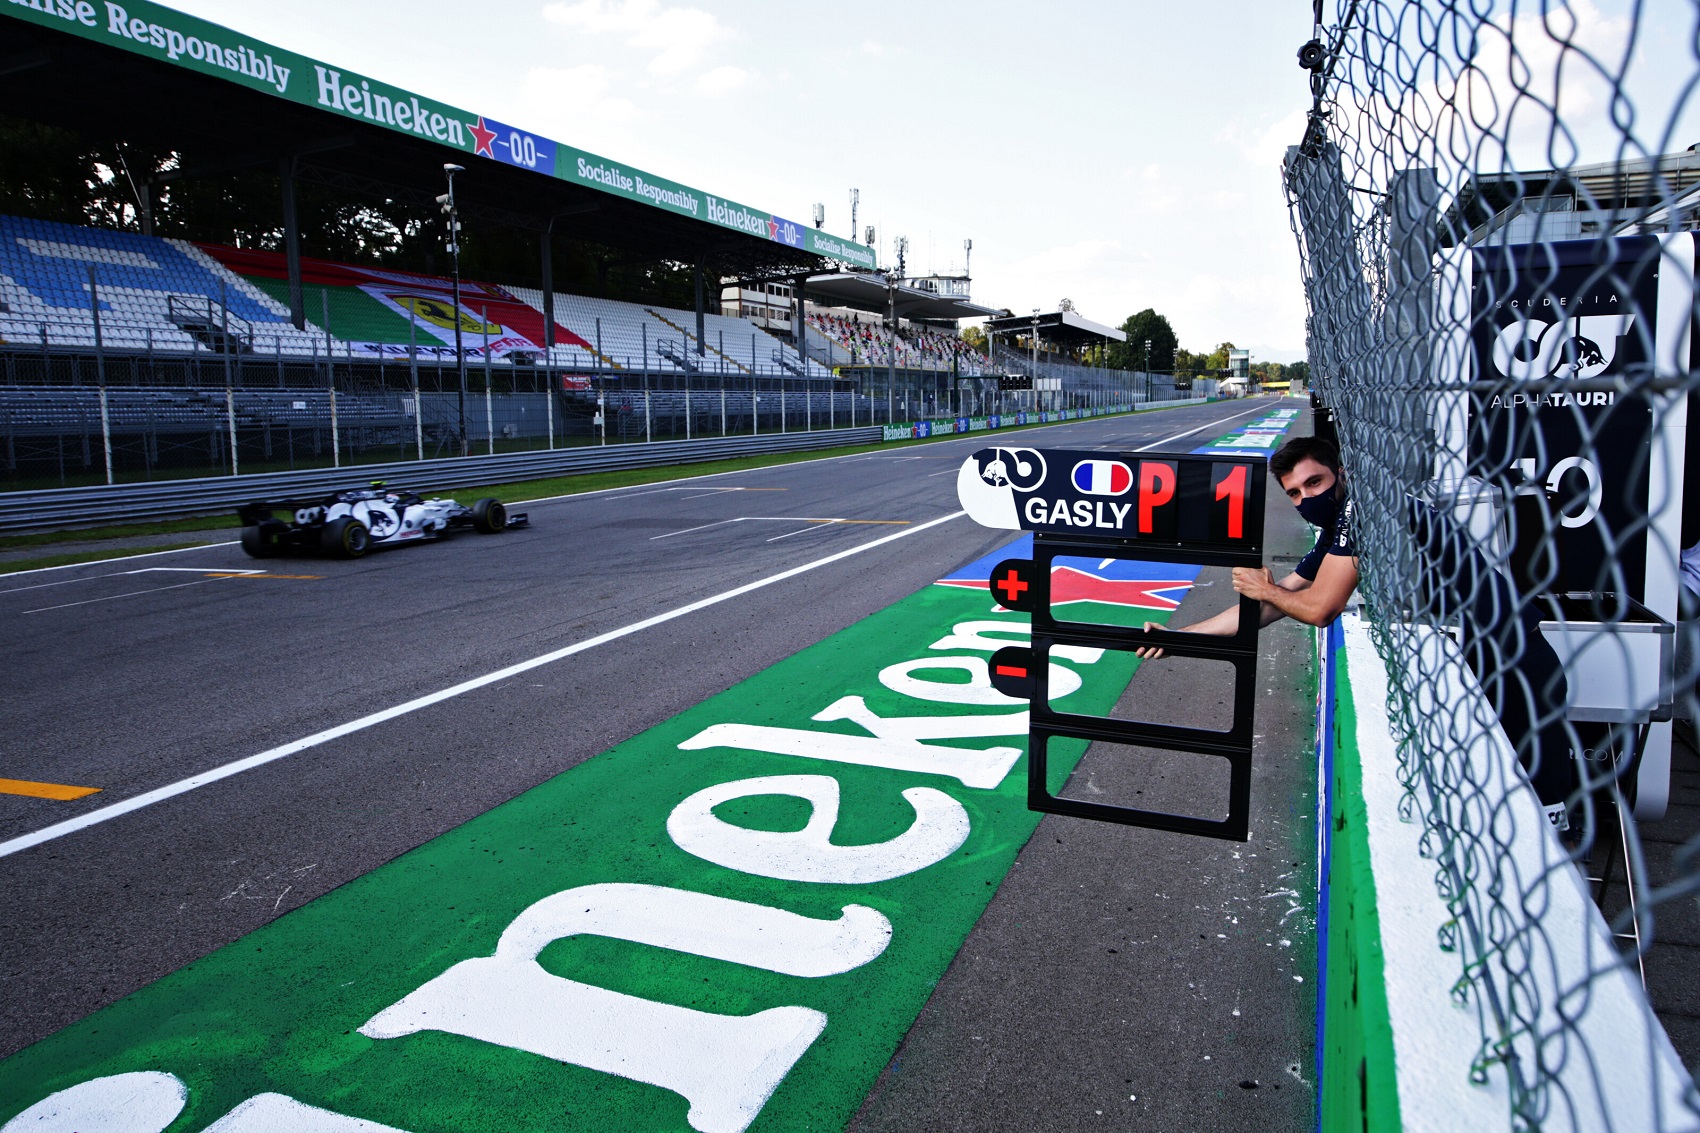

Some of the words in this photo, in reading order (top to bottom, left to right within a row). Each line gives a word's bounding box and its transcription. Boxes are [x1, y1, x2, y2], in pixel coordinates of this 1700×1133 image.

[104, 0, 291, 93] Responsibly
[314, 64, 466, 146] Heineken
[577, 158, 634, 192] Socialise
[635, 176, 699, 216] Responsibly
[706, 195, 766, 236] Heineken
[813, 234, 841, 255] Socialise
[841, 243, 873, 267] Responsibly
[1495, 295, 1618, 309] SCUDERIA
[1491, 391, 1614, 409] ALPHATAURI
[883, 425, 912, 441] Heineken
[931, 421, 953, 436] Heineken
[1024, 497, 1132, 529] GASLY
[1138, 461, 1177, 533] P
[1215, 465, 1248, 539] 1
